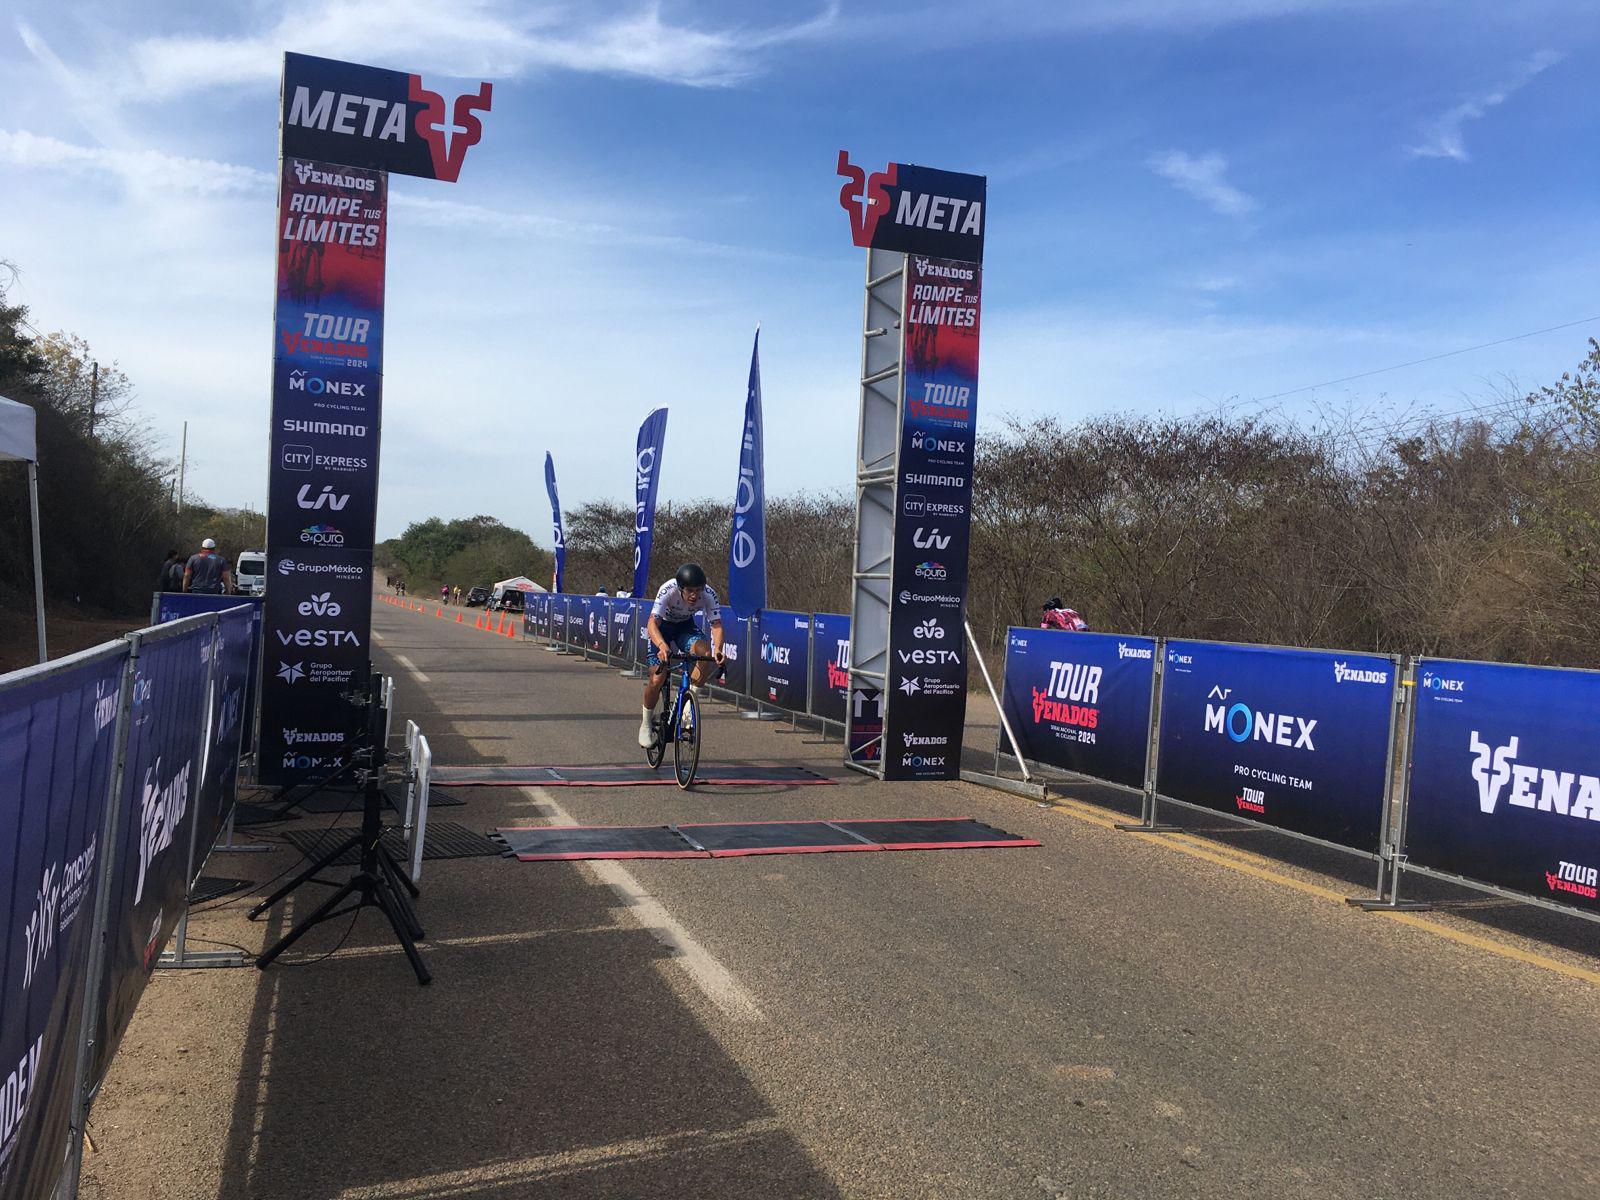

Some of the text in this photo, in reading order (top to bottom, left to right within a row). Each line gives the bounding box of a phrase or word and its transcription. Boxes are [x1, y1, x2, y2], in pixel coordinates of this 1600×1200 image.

[288, 85, 407, 143] META
[294, 160, 376, 192] VENADOS
[290, 193, 382, 219] ROMPE TUS
[895, 190, 981, 236] META
[283, 214, 380, 247] LÍMITES
[916, 256, 973, 280] VENADOS
[913, 284, 978, 304] ROMPE TUS
[909, 302, 977, 327] LÍMITES
[304, 312, 370, 343] TOUR
[347, 359, 368, 369] 2024
[289, 377, 366, 397] MONEX
[924, 383, 970, 407] TOUR
[283, 419, 367, 437] SHIMANO
[912, 437, 966, 453] MONEX
[284, 452, 368, 468] CITY EXPRESS
[905, 473, 964, 487] SHIMANO
[297, 483, 351, 511] Liv
[905, 501, 964, 514] CITY EXPRESS
[913, 527, 951, 550] Liv
[761, 642, 791, 665] MONEX
[1118, 642, 1152, 660] VENADOS
[1168, 653, 1193, 664] MONEX
[310, 662, 333, 670] Grupo
[1334, 660, 1388, 684] VENADOS
[1047, 661, 1103, 704] TOUR
[1423, 676, 1465, 692] MONEX
[1032, 686, 1099, 729] VENADOS
[283, 727, 345, 745] VENADOS
[1078, 730, 1096, 745] 2024
[1204, 702, 1318, 751] MONEX
[903, 732, 948, 748] VENADOS
[283, 755, 343, 768] MONX
[902, 757, 945, 768] MONEX
[1234, 764, 1313, 791] PRO CYCLING TEAM
[1243, 786, 1265, 805] TOUR
[1545, 870, 1598, 899] VENADOS
[1559, 860, 1599, 887] TOUR
